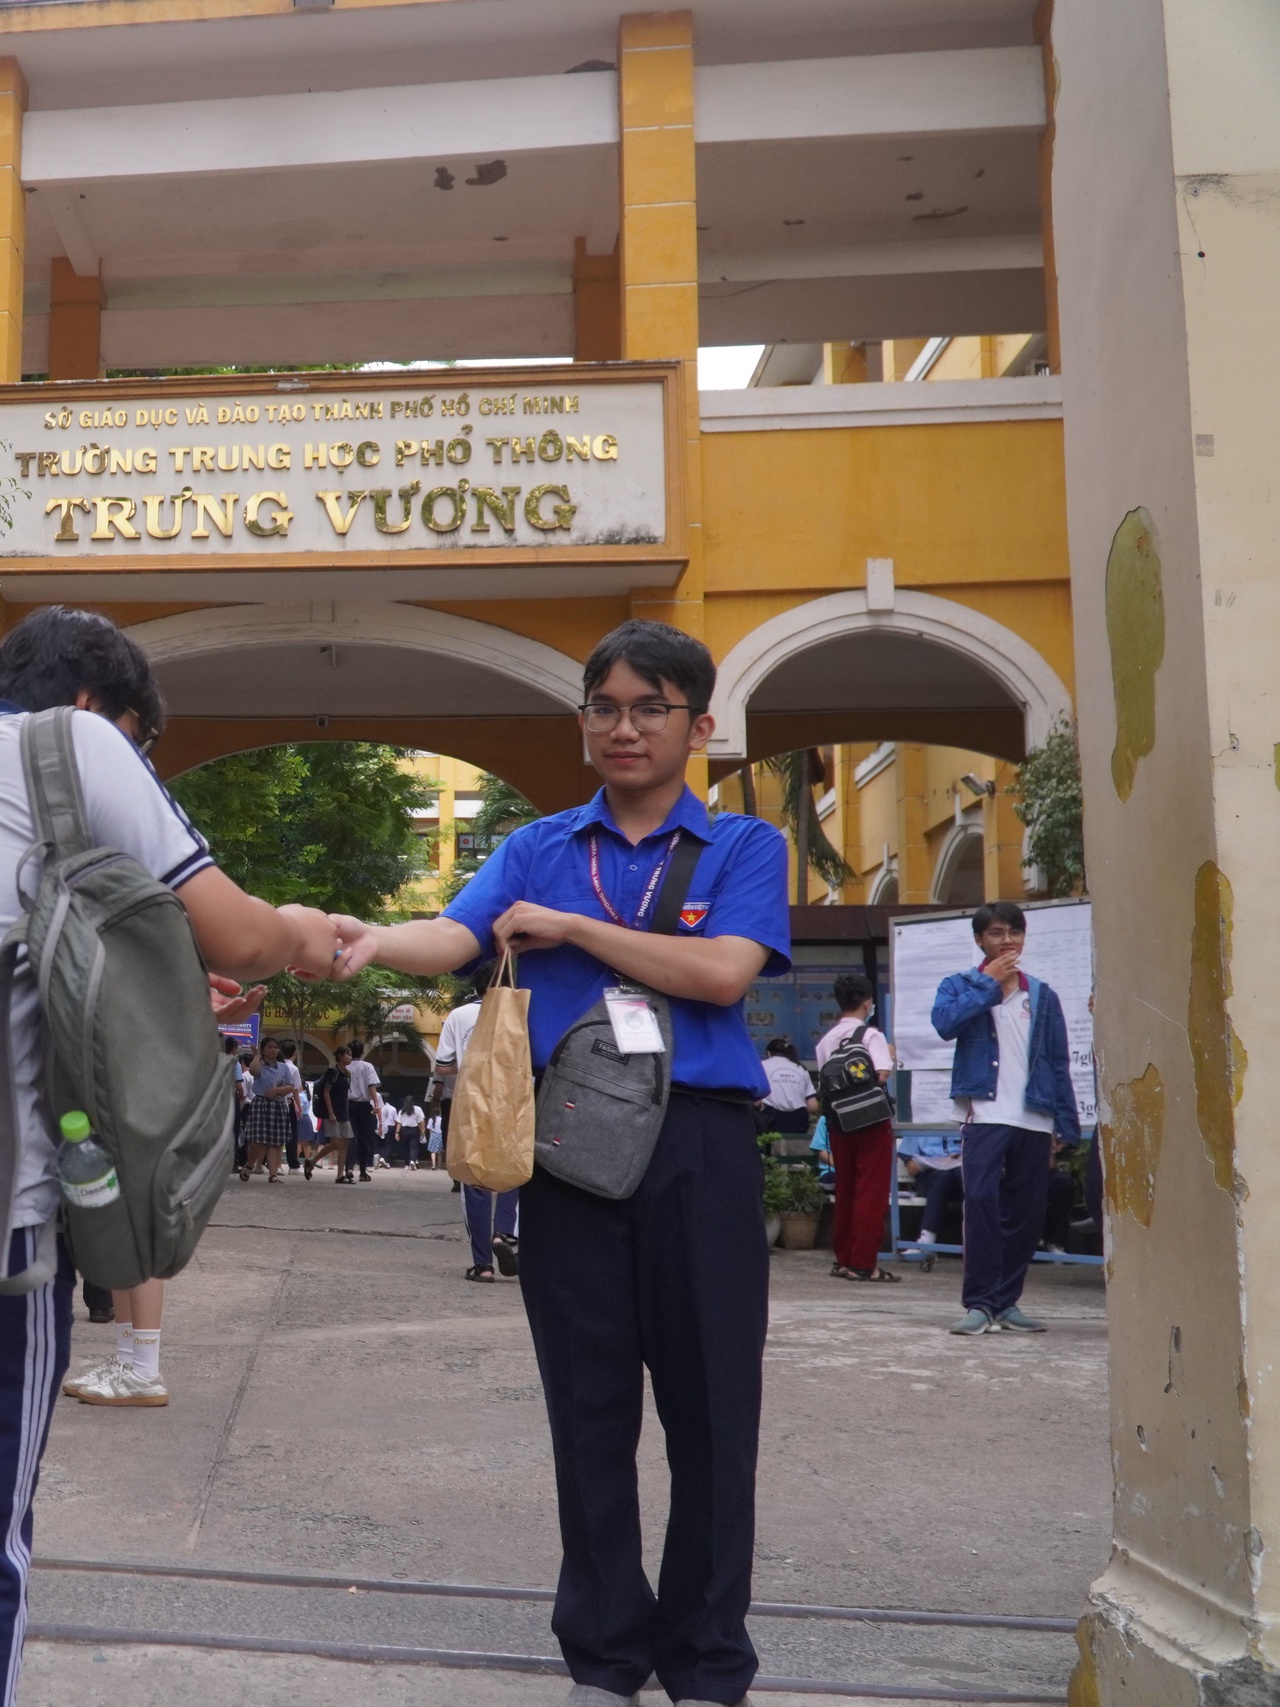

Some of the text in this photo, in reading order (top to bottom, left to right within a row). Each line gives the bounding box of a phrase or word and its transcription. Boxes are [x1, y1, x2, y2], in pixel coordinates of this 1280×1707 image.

[43, 391, 580, 430] SỞ GIÁO DỤC VÀ ĐÀO TẠO THÀNH PHỐ HỒ CHÍ MINH
[14, 423, 619, 478] TRƯỜNG TRUNG HỌC PHỔ THÔNG
[44, 477, 578, 542] TRƯNG VƯƠNG
[637, 891, 653, 917] VƯƠNG
